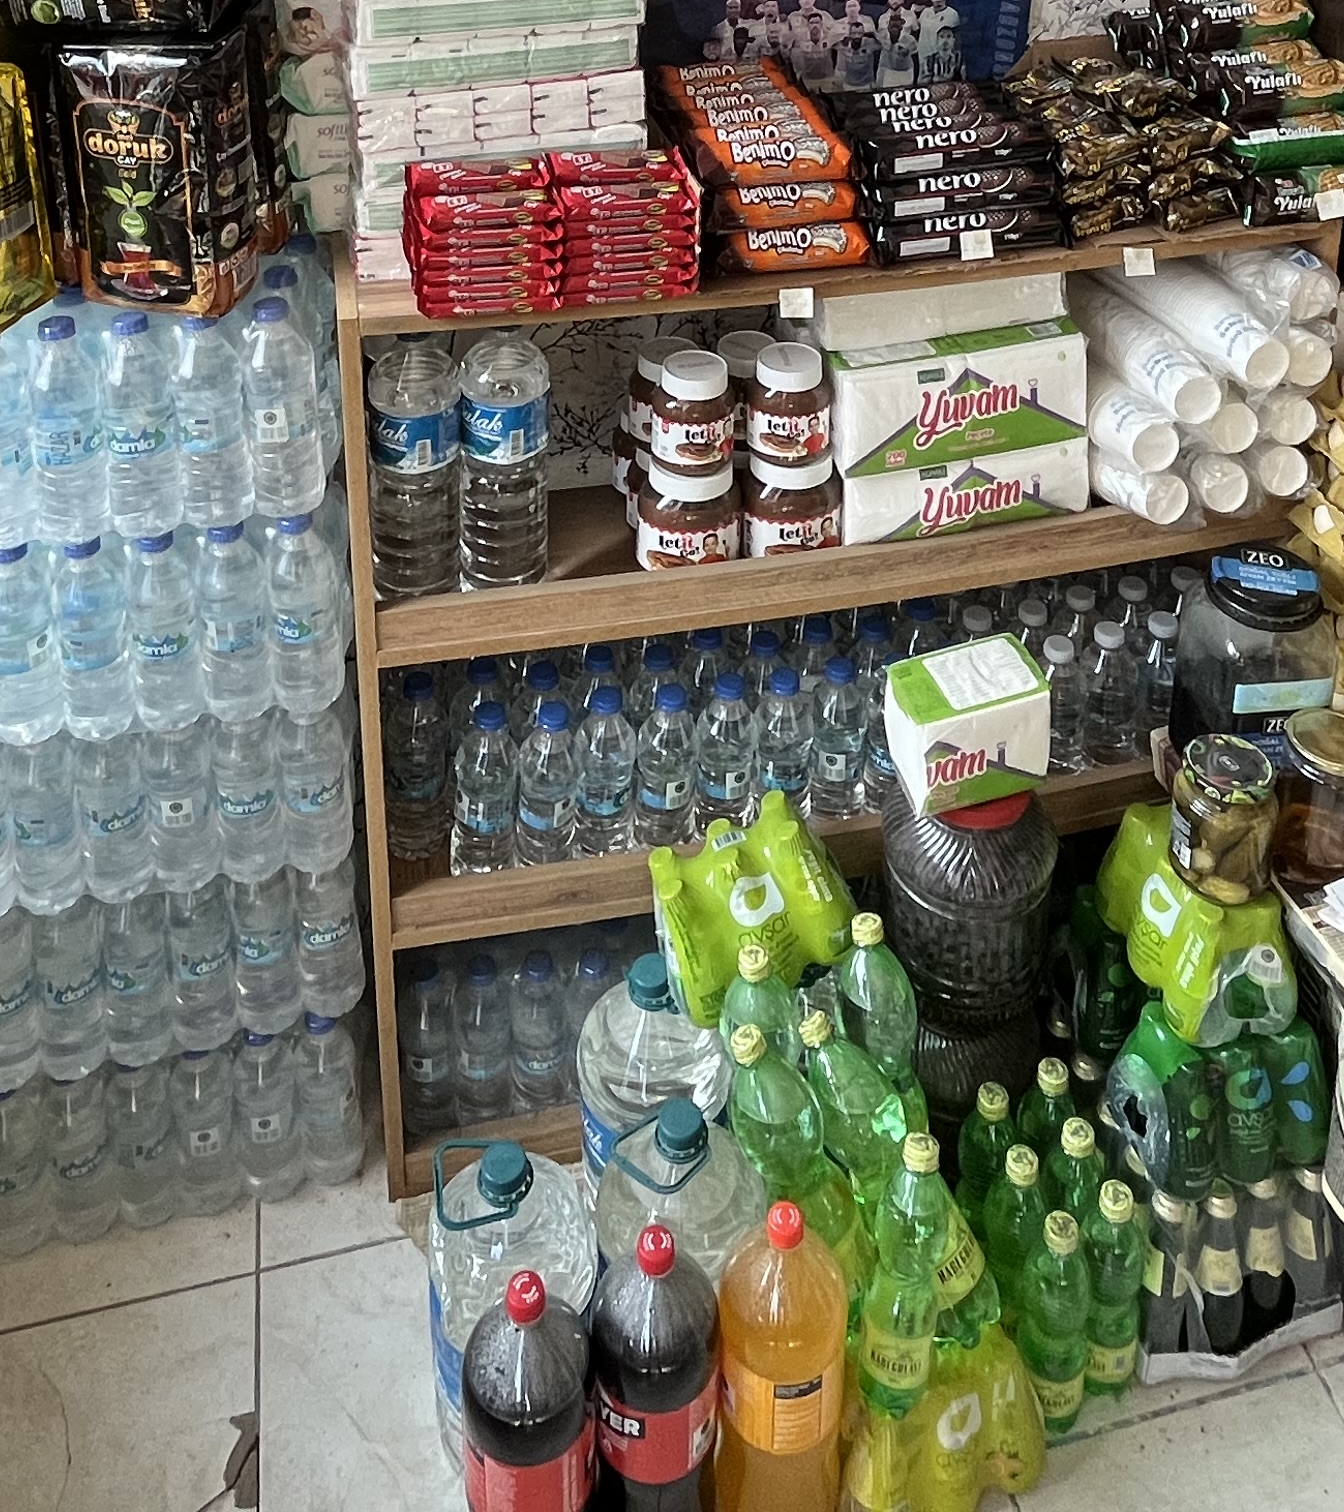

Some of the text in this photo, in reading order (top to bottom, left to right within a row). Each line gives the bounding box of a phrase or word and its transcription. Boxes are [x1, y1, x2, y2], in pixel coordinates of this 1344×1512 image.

[872, 87, 931, 108] nero
[878, 101, 939, 125] nero
[88, 132, 169, 160] doruk
[914, 128, 978, 150] nero
[917, 172, 982, 194] nero
[1274, 195, 1317, 213] Yula
[923, 211, 988, 234] nero
[916, 383, 1019, 449] Yuvam
[110, 437, 156, 454] damla
[918, 478, 1022, 538] Yuvam
[1246, 550, 1284, 568] ZEO
[277, 625, 300, 639] mla
[1266, 719, 1285, 733] ZE
[926, 746, 987, 789] vam
